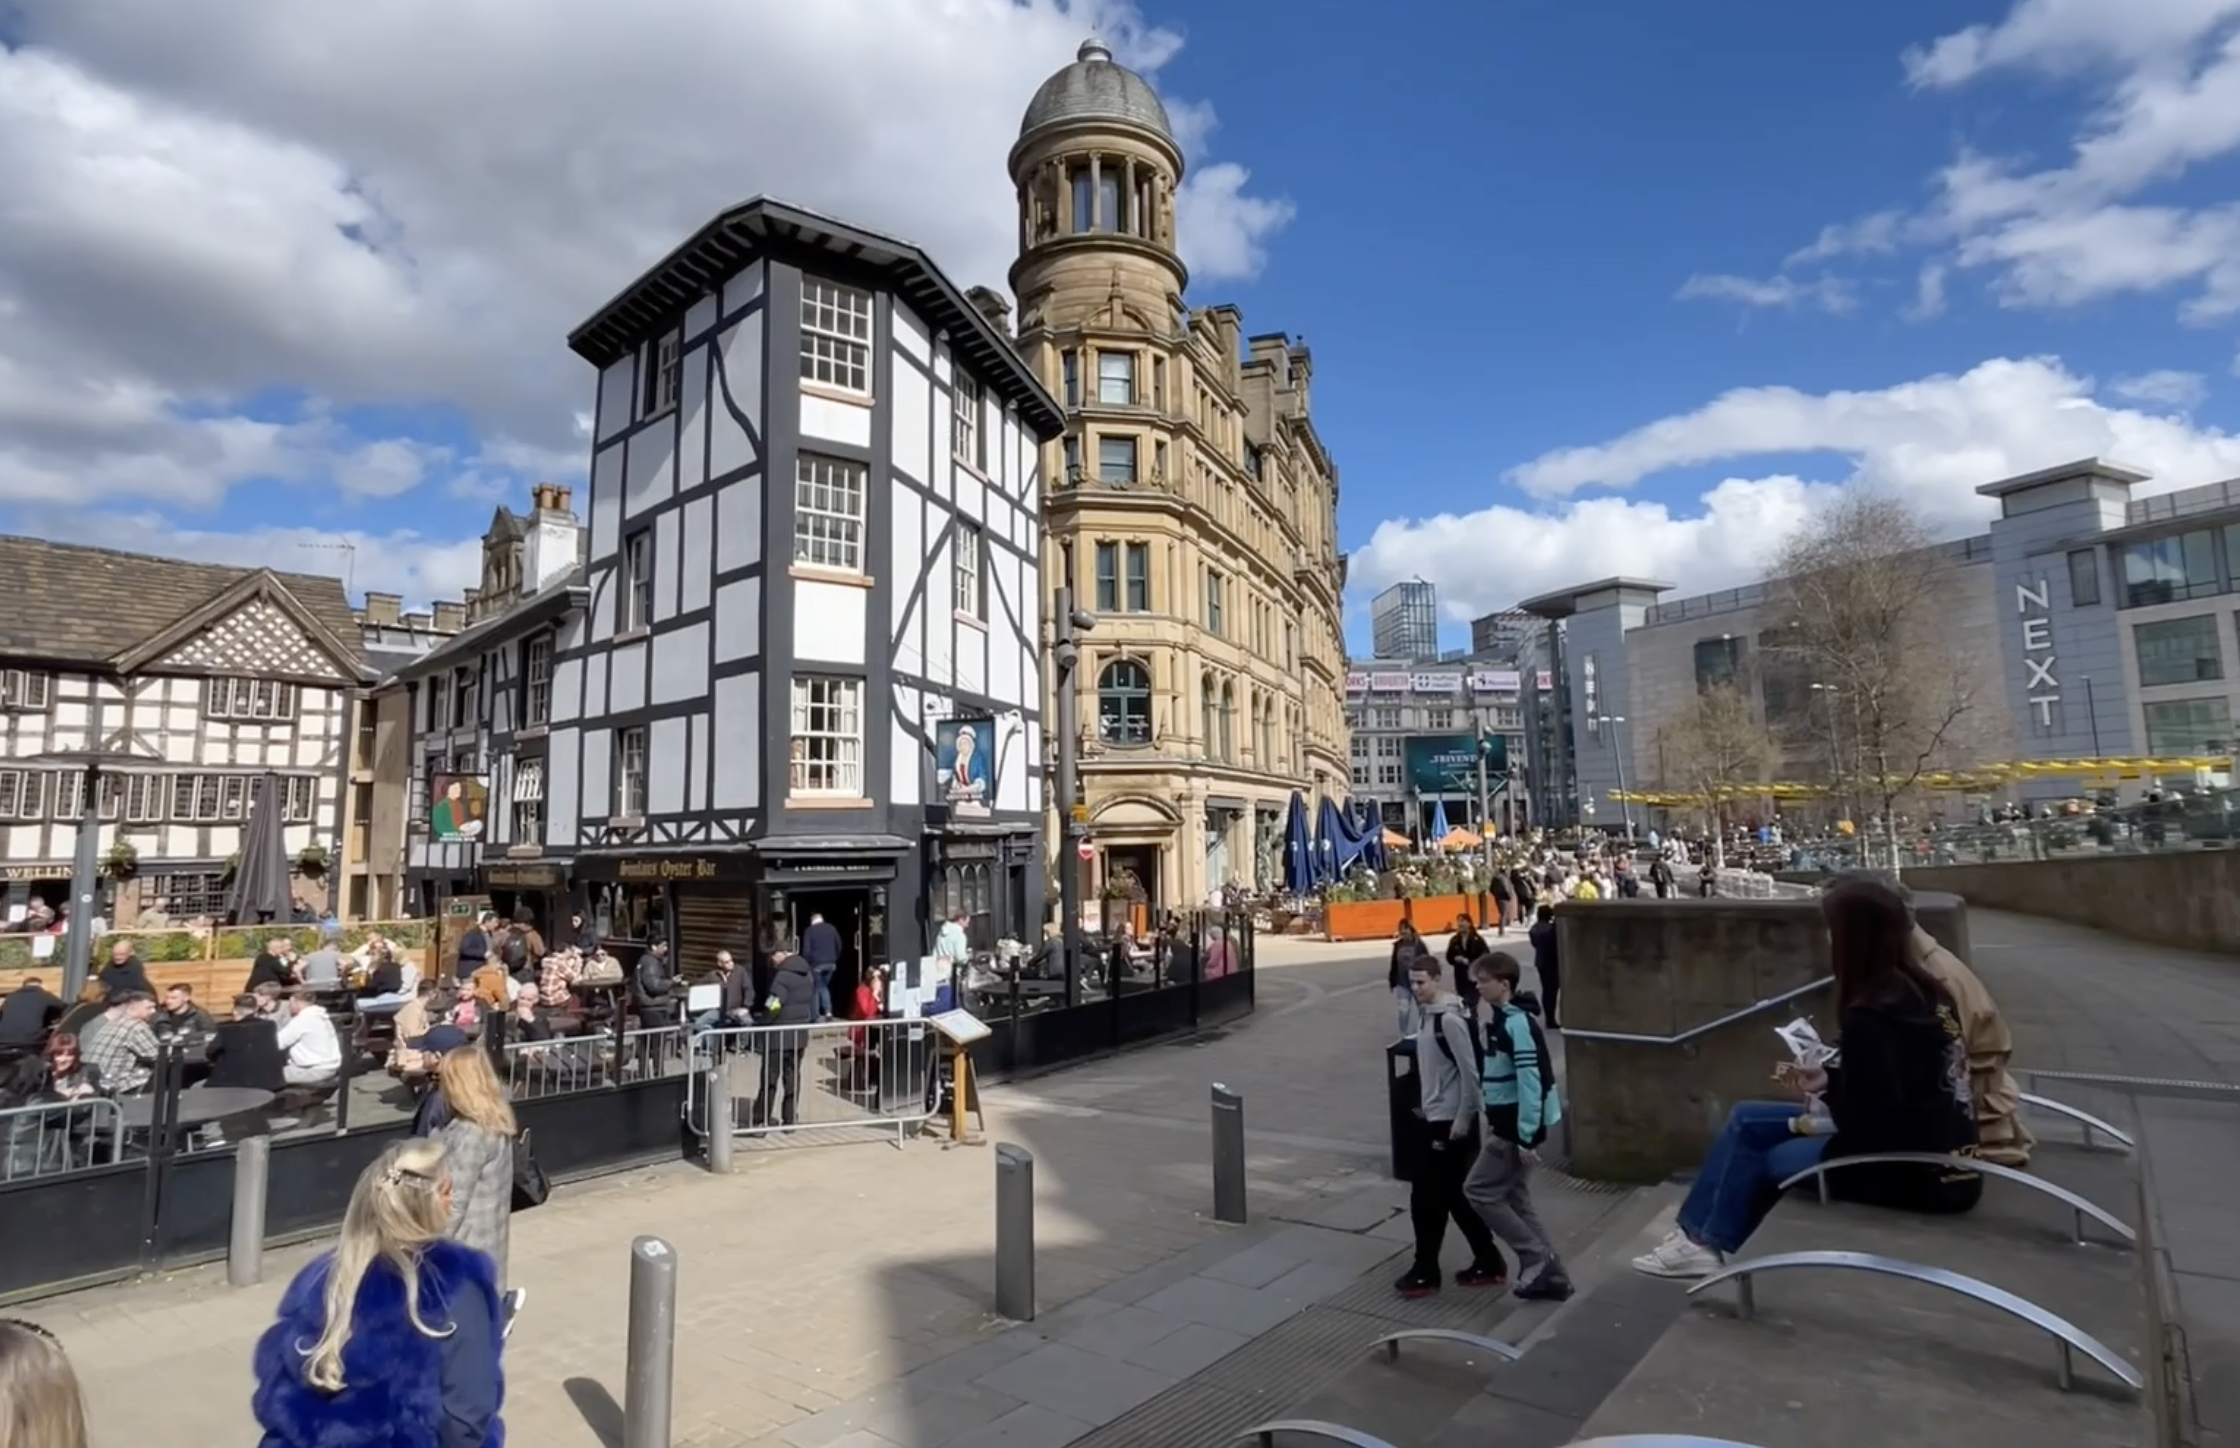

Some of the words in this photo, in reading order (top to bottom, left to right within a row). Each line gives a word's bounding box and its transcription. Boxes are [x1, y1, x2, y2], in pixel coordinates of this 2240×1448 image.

[2016, 579, 2060, 726] NEXT
[660, 859, 692, 880] Oyster
[696, 858, 716, 877] Bar
